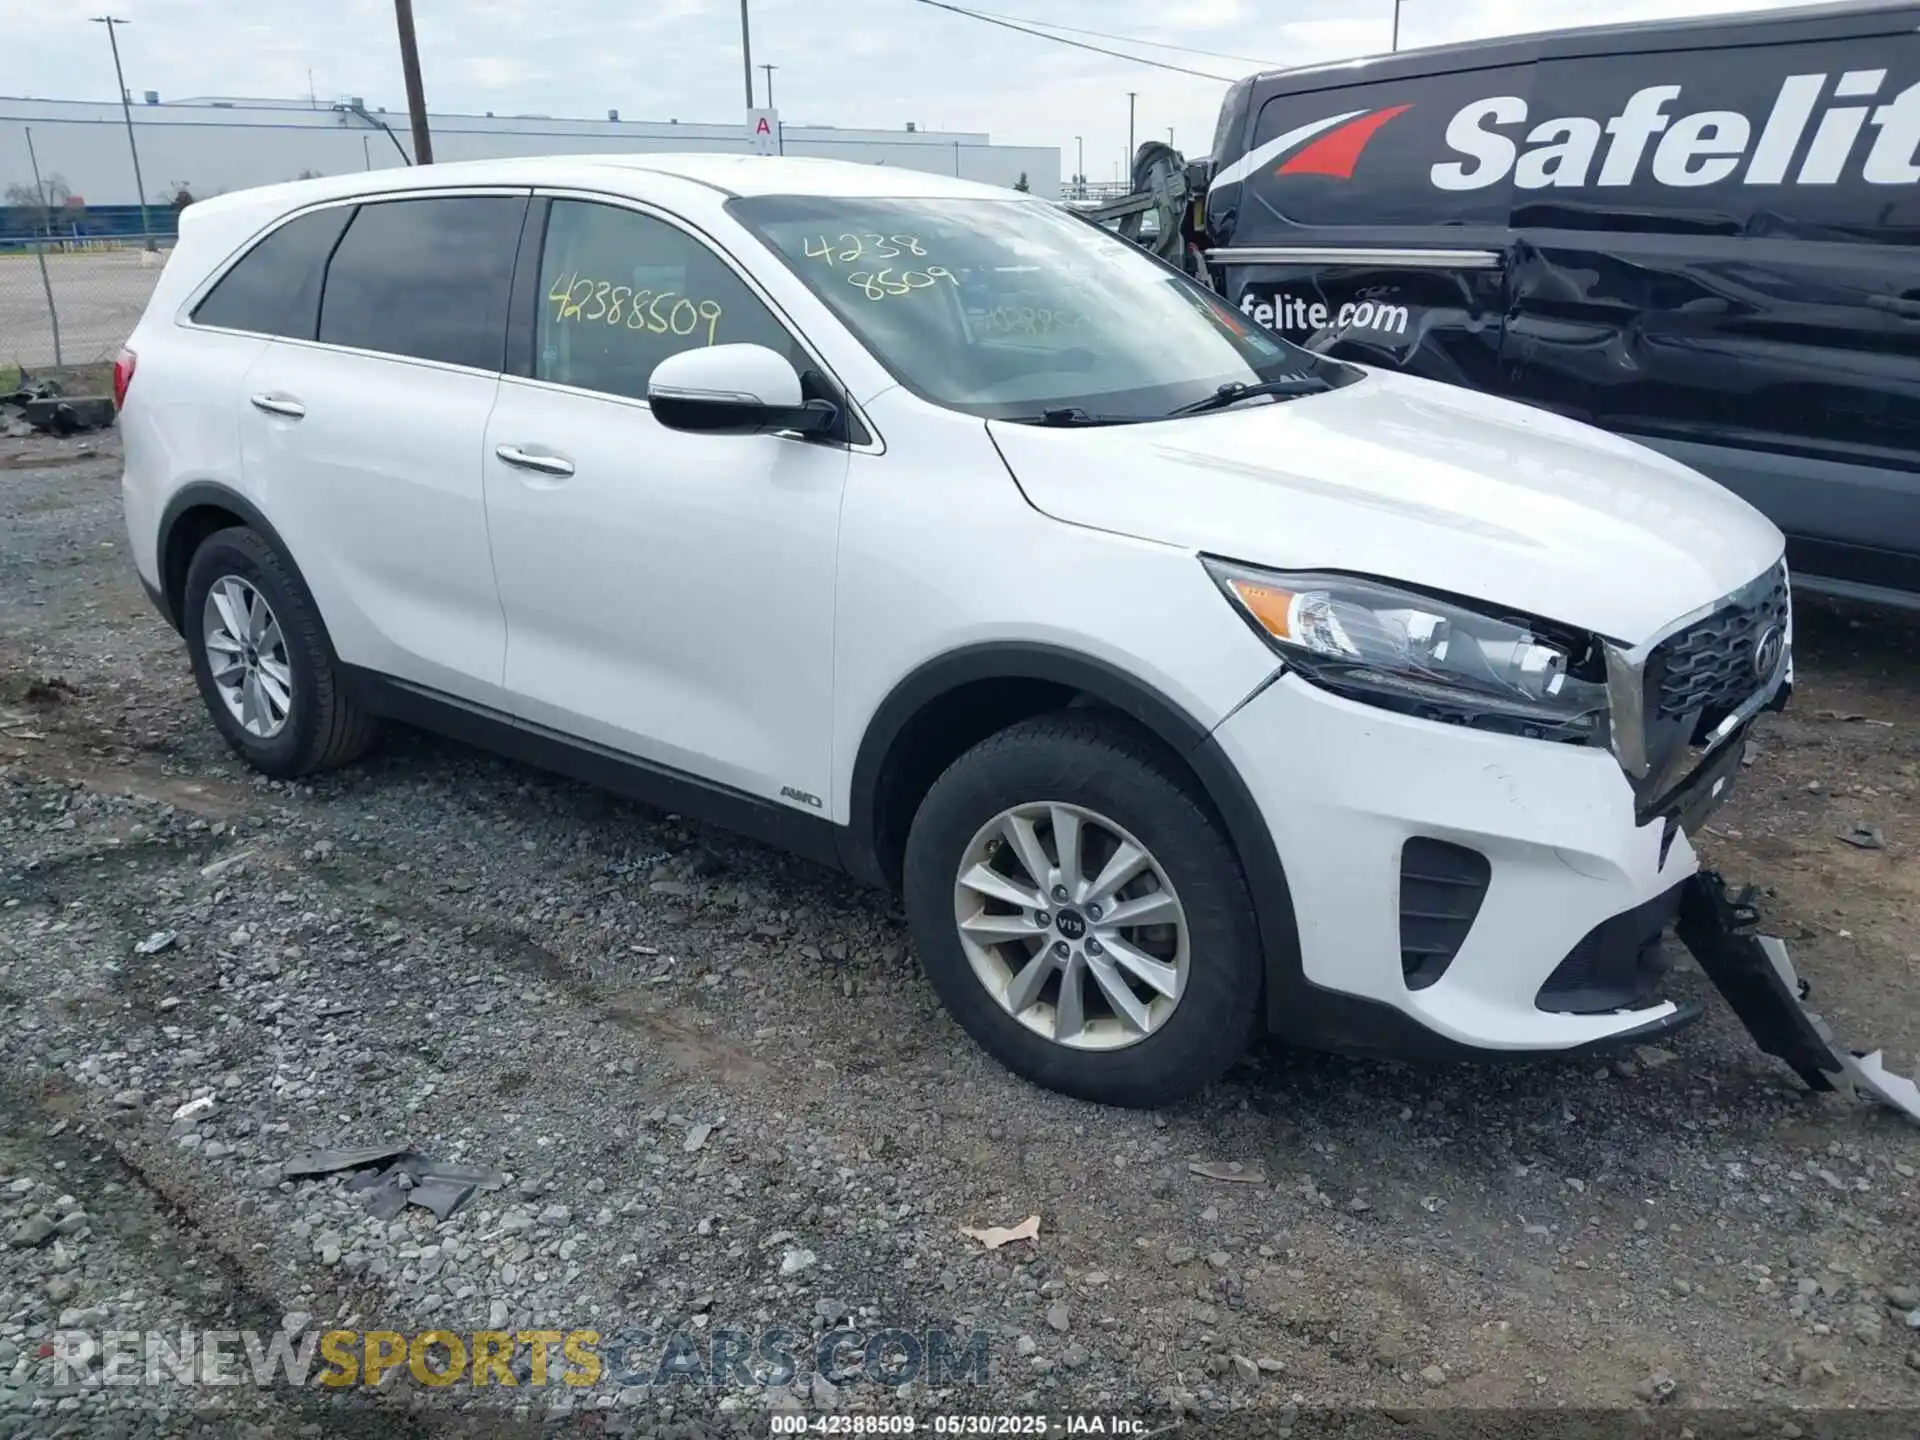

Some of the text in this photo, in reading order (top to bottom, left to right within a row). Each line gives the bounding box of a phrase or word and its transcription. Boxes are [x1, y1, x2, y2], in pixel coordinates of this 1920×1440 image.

[756, 117, 771, 135] A
[1430, 69, 1920, 191] Safelit
[803, 233, 928, 267] 4238
[847, 265, 961, 301] 8509
[548, 271, 722, 347] 42388509
[780, 785, 823, 809] AWD
